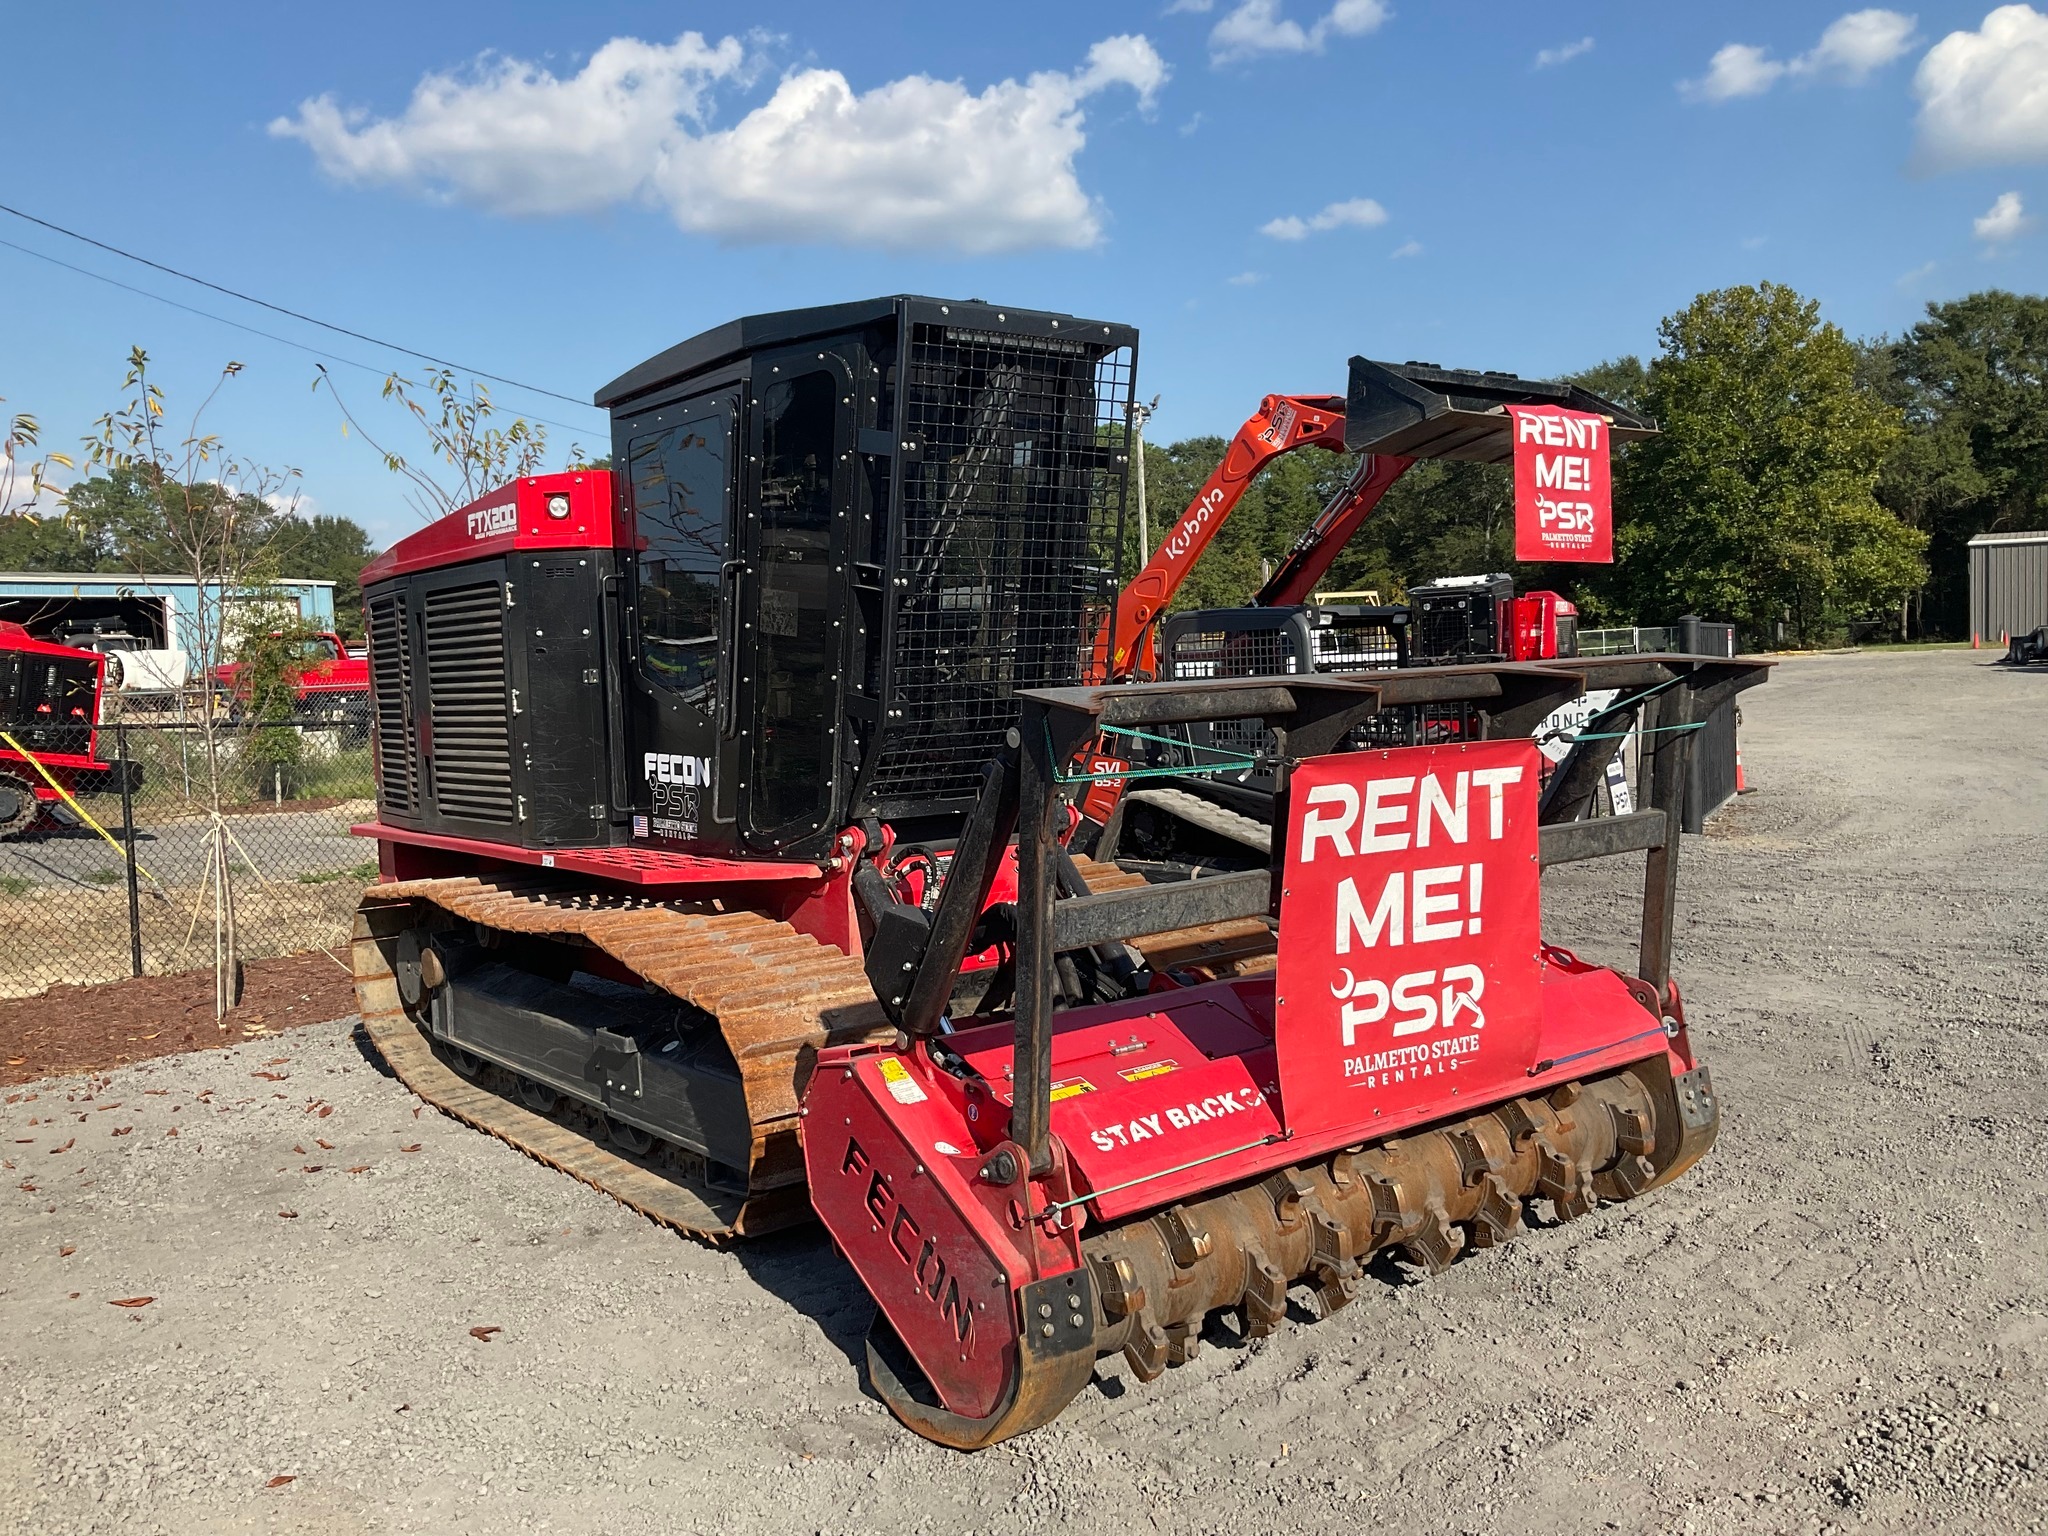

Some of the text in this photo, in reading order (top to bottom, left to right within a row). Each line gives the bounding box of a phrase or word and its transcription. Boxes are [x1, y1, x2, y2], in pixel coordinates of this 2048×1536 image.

[1517, 411, 1602, 450] RENT
[1535, 453, 1591, 491] ME!
[467, 502, 518, 536] FTX200
[1164, 488, 1225, 560] Kubota
[1537, 499, 1595, 533] PSR
[1541, 532, 1593, 543] PALMETTO STATE
[644, 752, 711, 788] FECON
[1094, 778, 1121, 788] 65-2
[651, 782, 701, 822] PSR
[1300, 766, 1524, 863] RENT
[1335, 862, 1484, 956] ME!
[1338, 963, 1486, 1047] PSR
[1343, 1033, 1481, 1078] PALMETTO STATE
[1367, 1058, 1458, 1089] RENTALS
[1090, 1114, 1165, 1152] STAY
[1166, 1092, 1246, 1130] BACK
[839, 1135, 974, 1343] FECON
